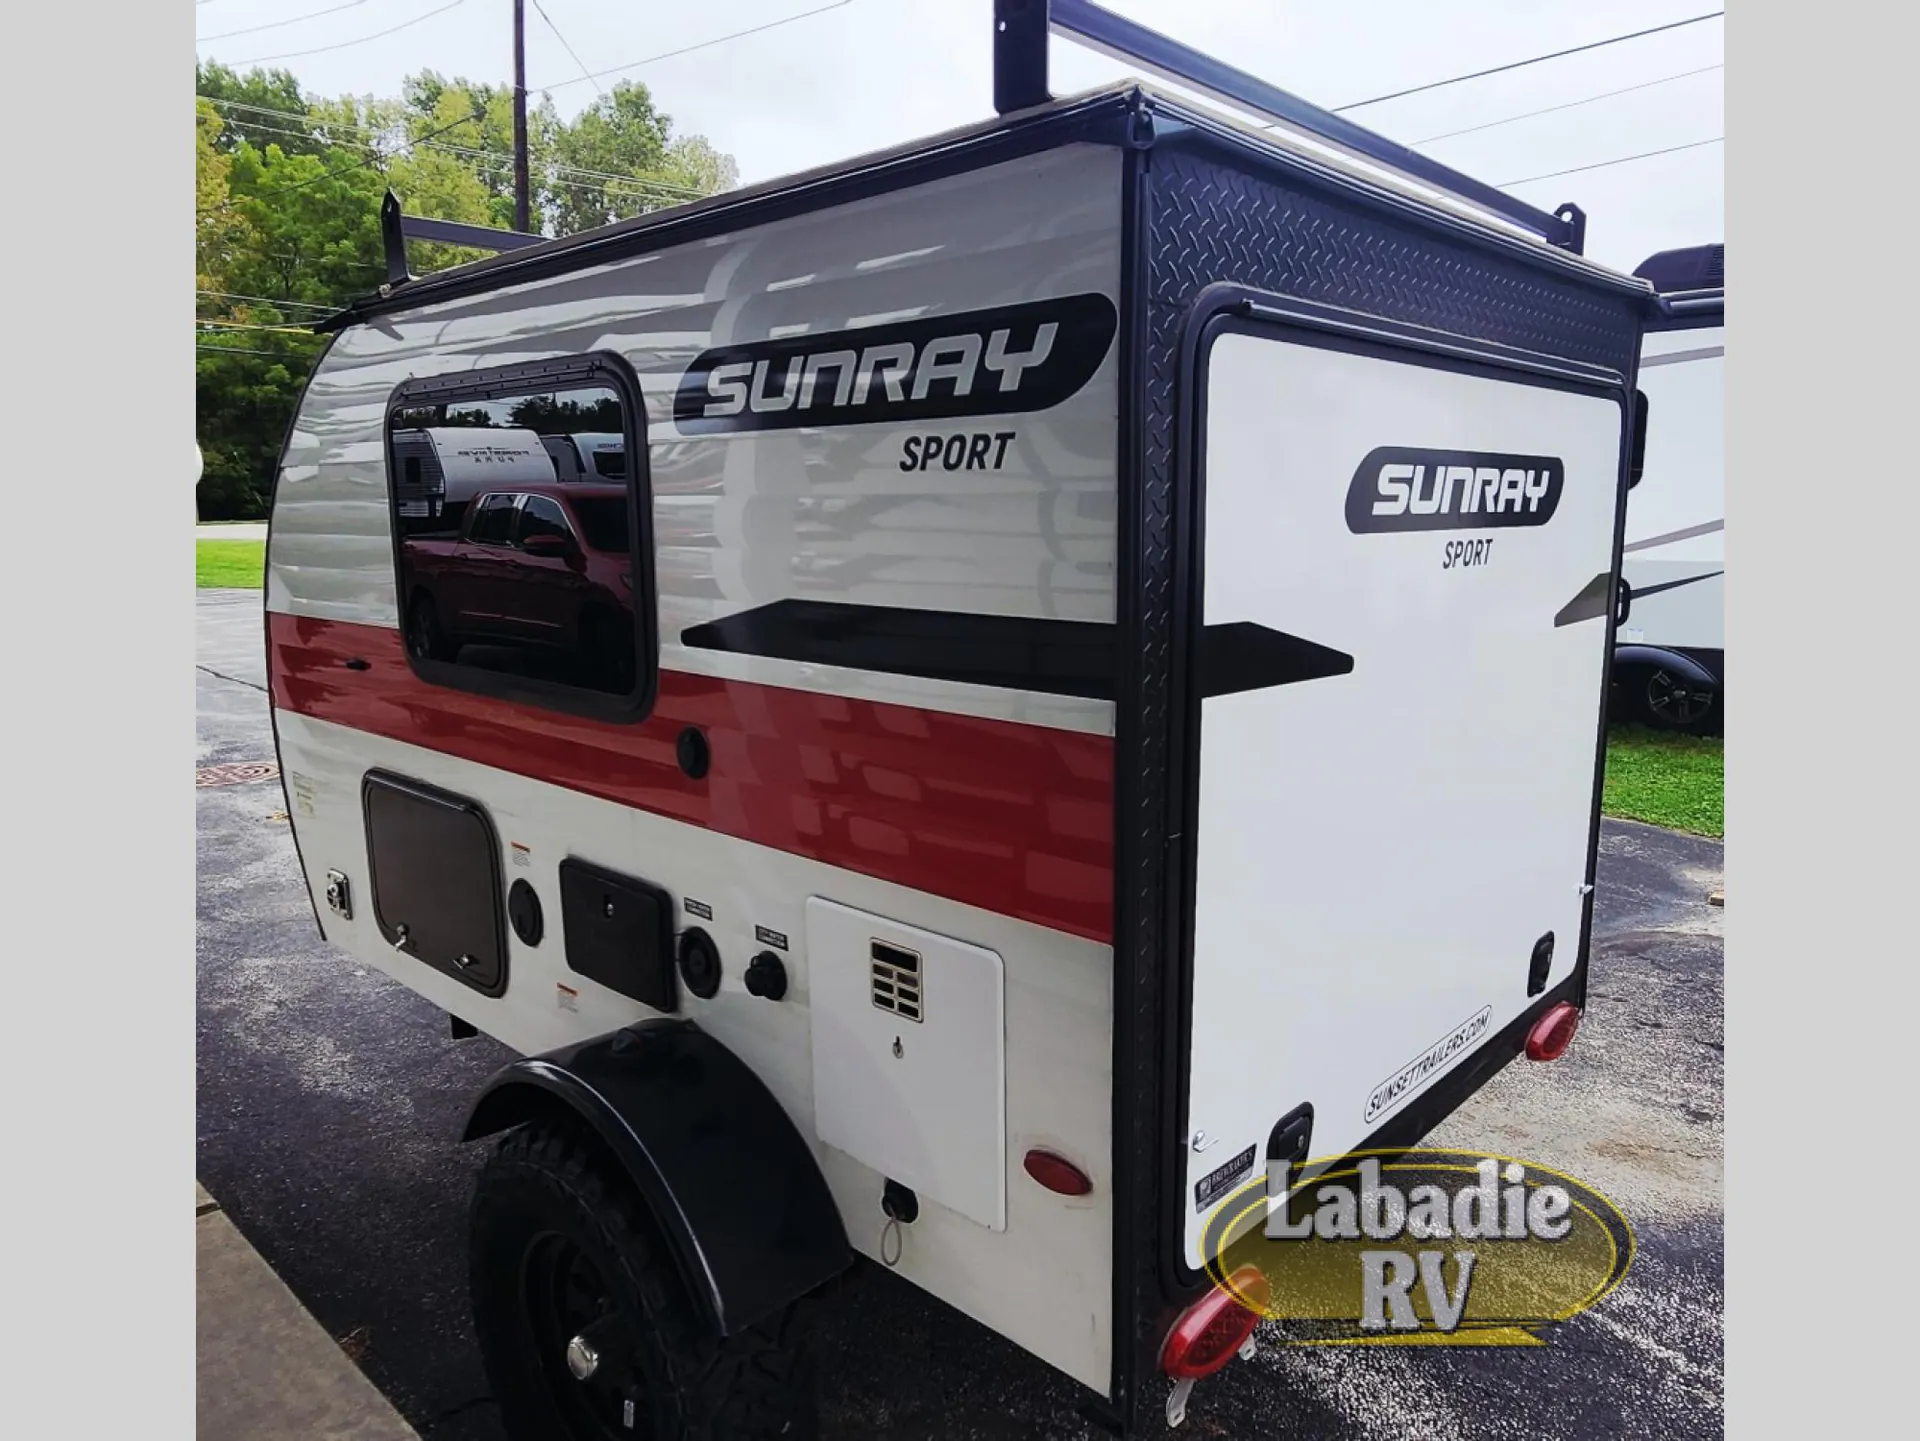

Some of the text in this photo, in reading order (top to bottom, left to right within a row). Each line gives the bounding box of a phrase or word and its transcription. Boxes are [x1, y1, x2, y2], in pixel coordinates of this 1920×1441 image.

[702, 321, 1060, 418] SUNRAY
[899, 430, 1016, 472] SPORT
[1371, 463, 1550, 516] SUNRAY
[1442, 538, 1494, 570] SPORT
[1367, 1009, 1491, 1118] SUNSETTRAILERS.COM
